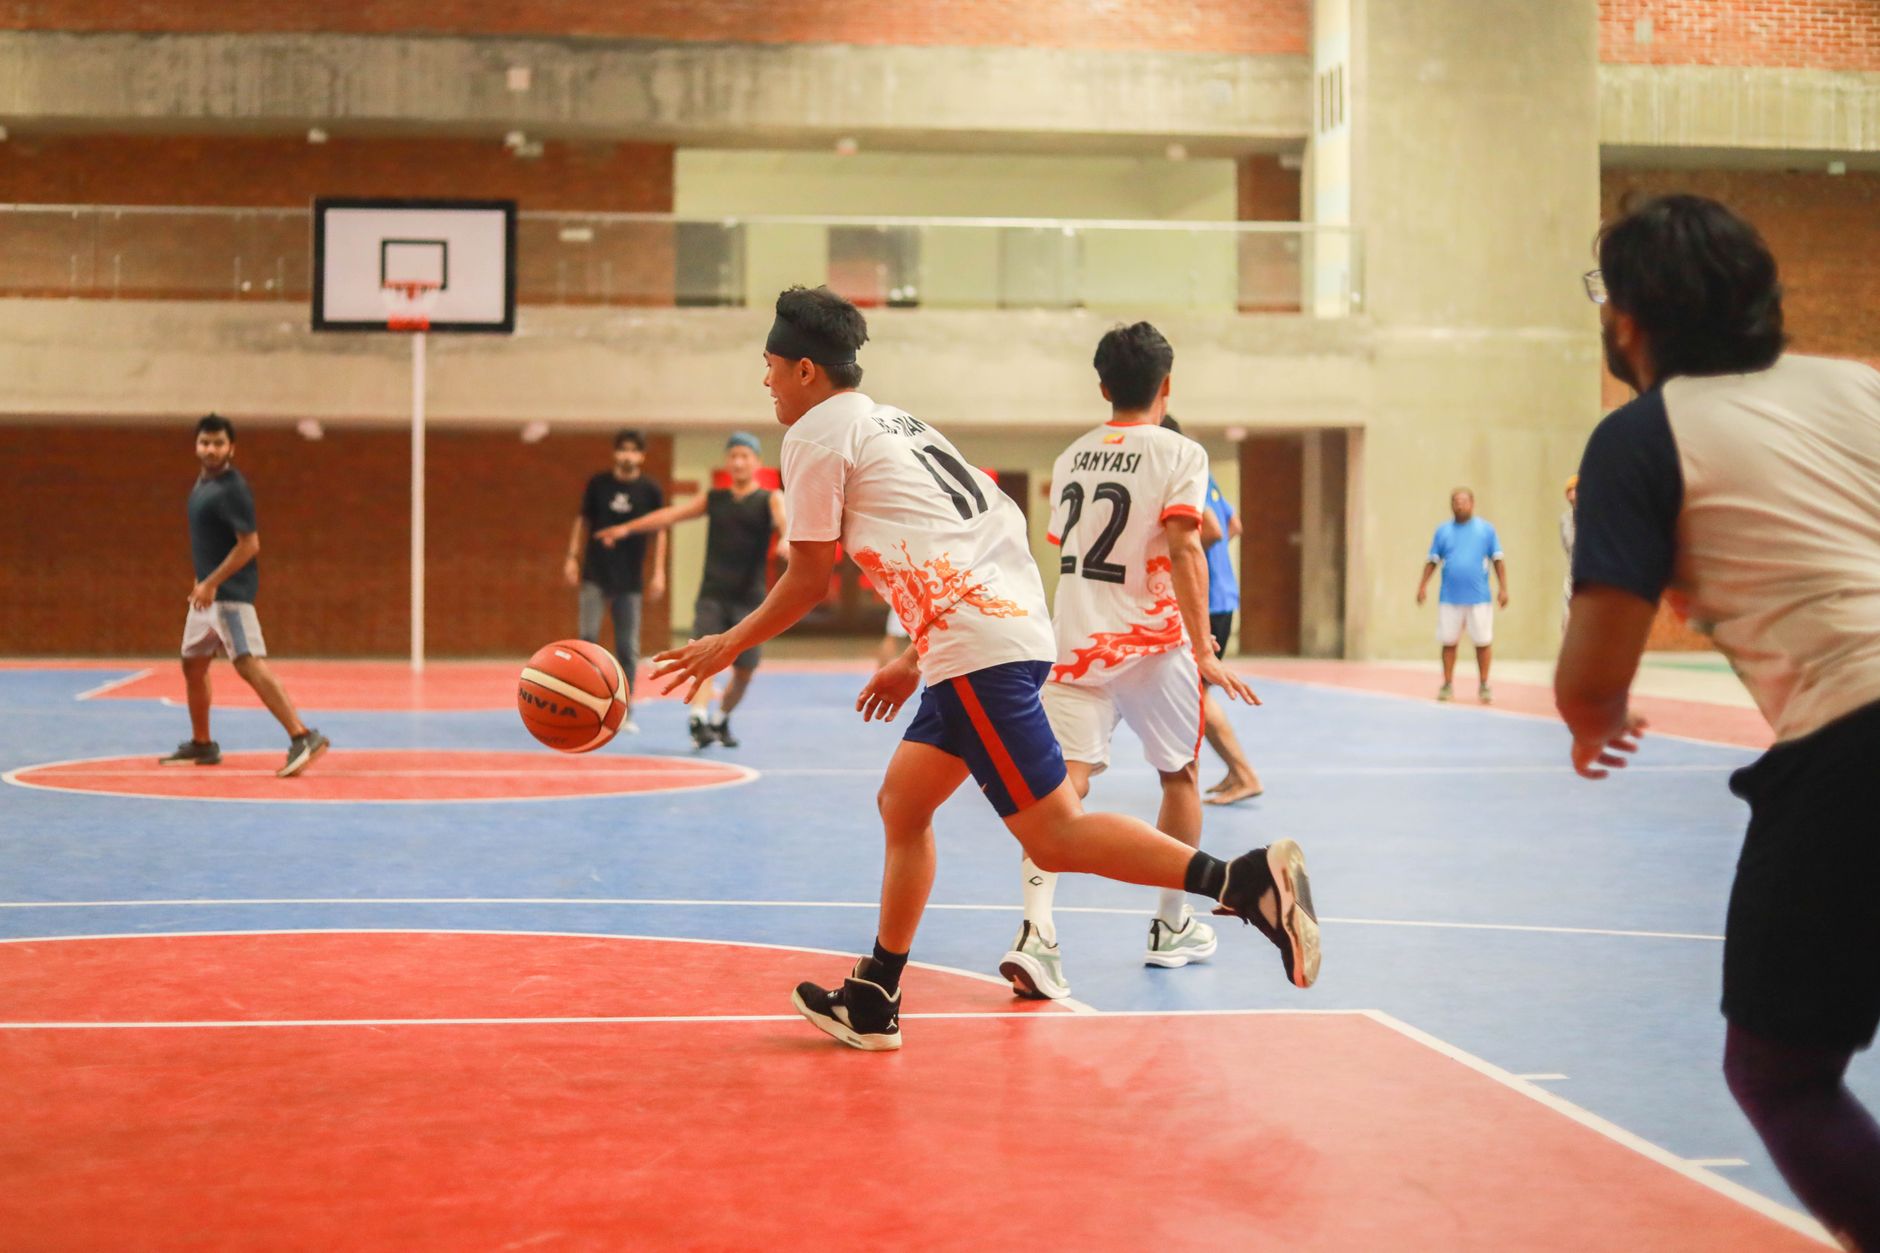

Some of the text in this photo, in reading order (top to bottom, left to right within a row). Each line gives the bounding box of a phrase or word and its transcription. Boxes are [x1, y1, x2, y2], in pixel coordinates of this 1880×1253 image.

[1070, 451, 1142, 474] SANYASI
[1059, 481, 1132, 585] 22
[519, 687, 577, 719] NIVIA
